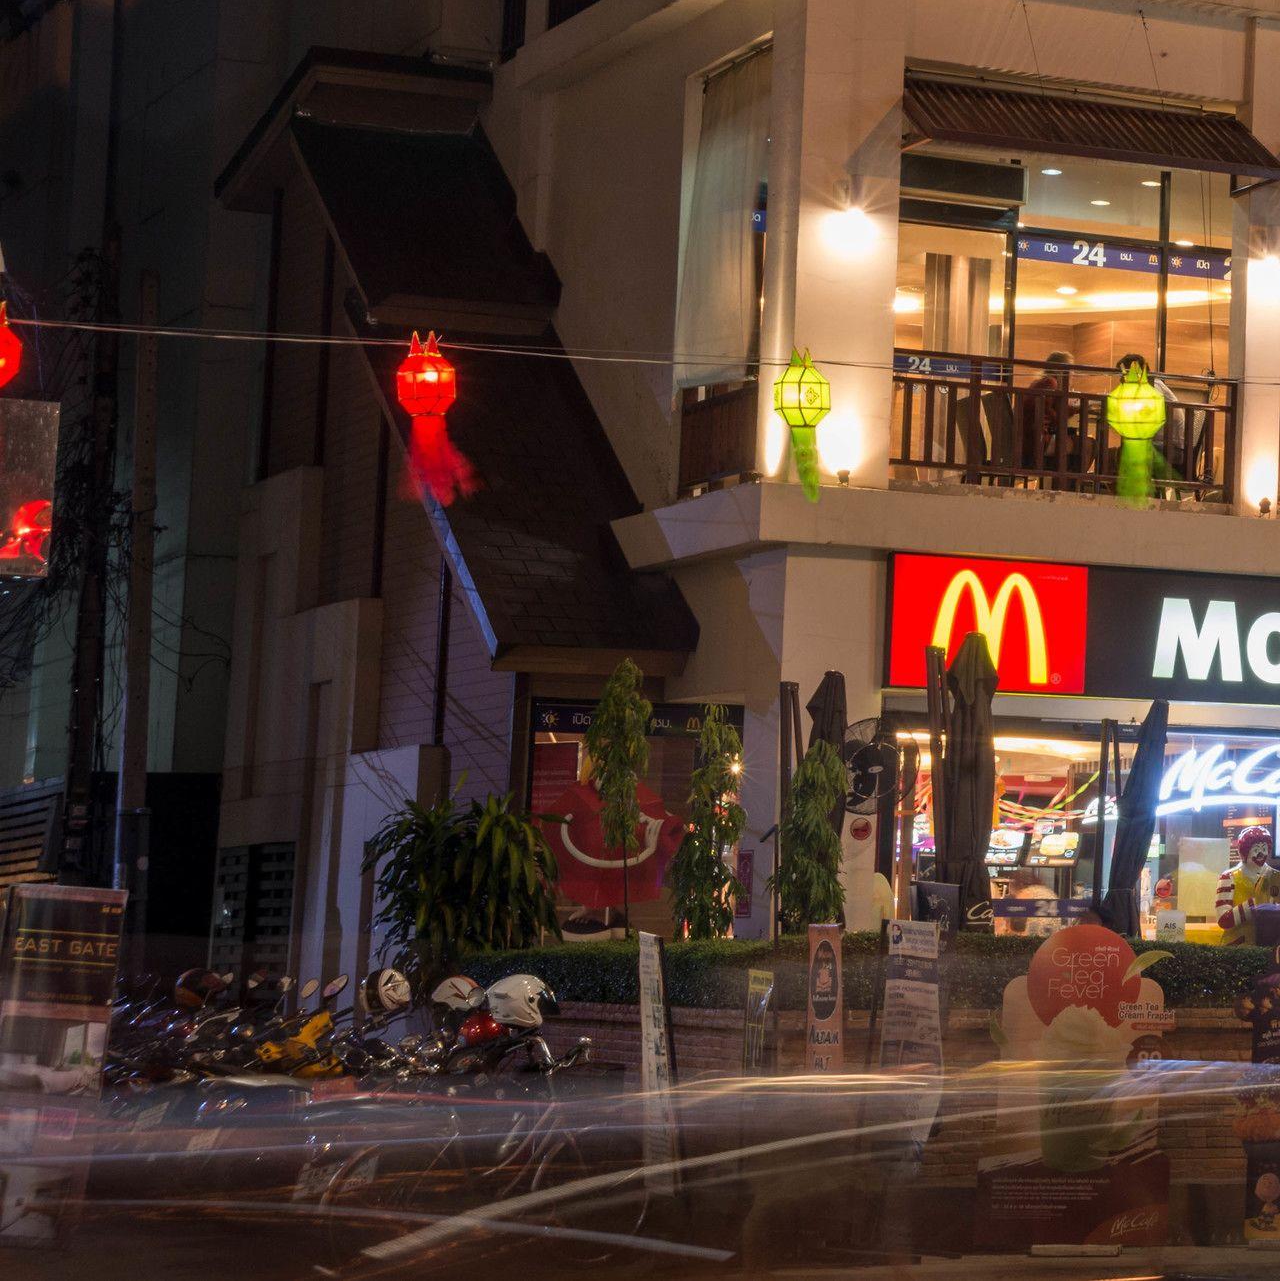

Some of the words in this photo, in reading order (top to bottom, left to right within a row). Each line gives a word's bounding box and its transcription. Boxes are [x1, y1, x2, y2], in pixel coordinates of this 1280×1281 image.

[1072, 240, 1107, 267] 24
[908, 355, 932, 374] 24
[1163, 921, 1178, 931] AIS
[14, 936, 64, 953] EAST
[70, 940, 118, 958] GATE
[1051, 947, 1120, 968] Green
[1066, 965, 1105, 985] Tea
[1047, 978, 1109, 999] Fever
